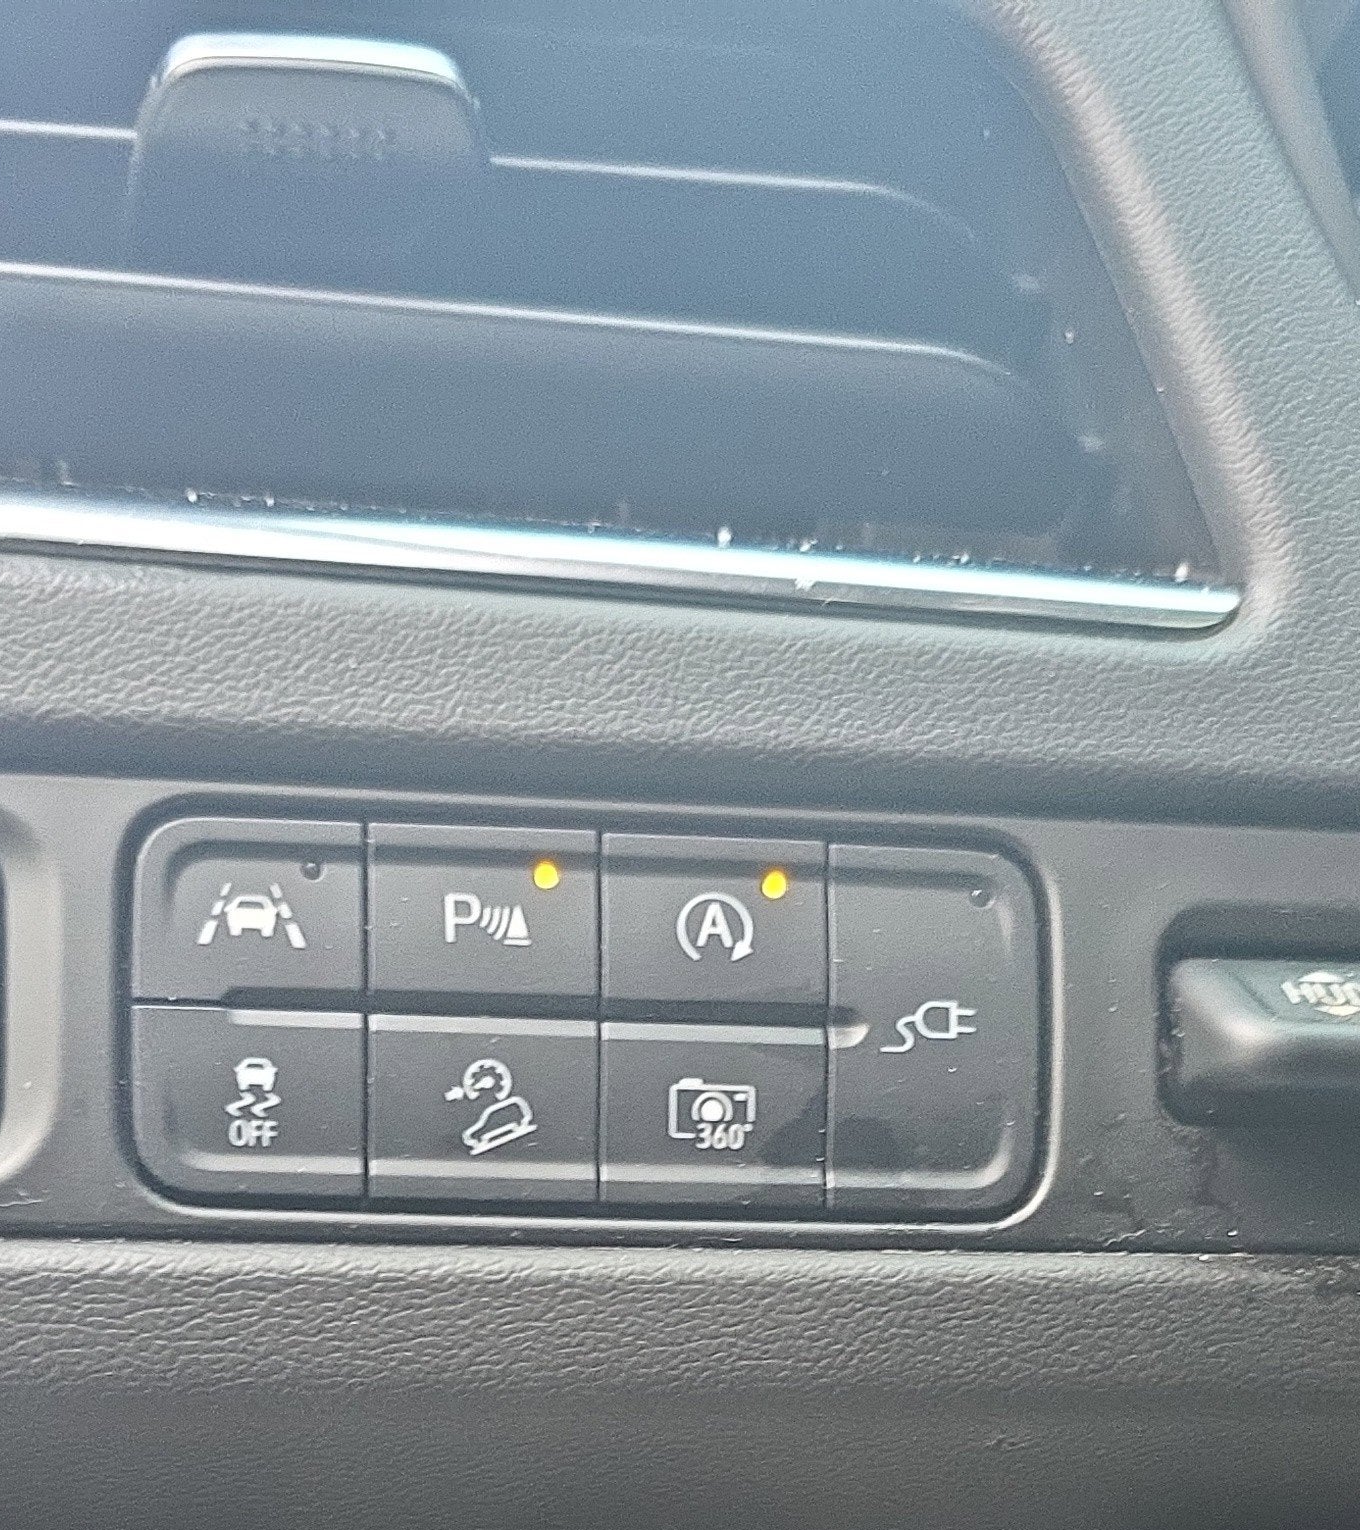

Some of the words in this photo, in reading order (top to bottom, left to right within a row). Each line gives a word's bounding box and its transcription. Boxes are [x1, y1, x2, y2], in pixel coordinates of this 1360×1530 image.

[444, 892, 482, 944] P
[696, 902, 734, 949] A
[228, 1119, 279, 1148] OFF
